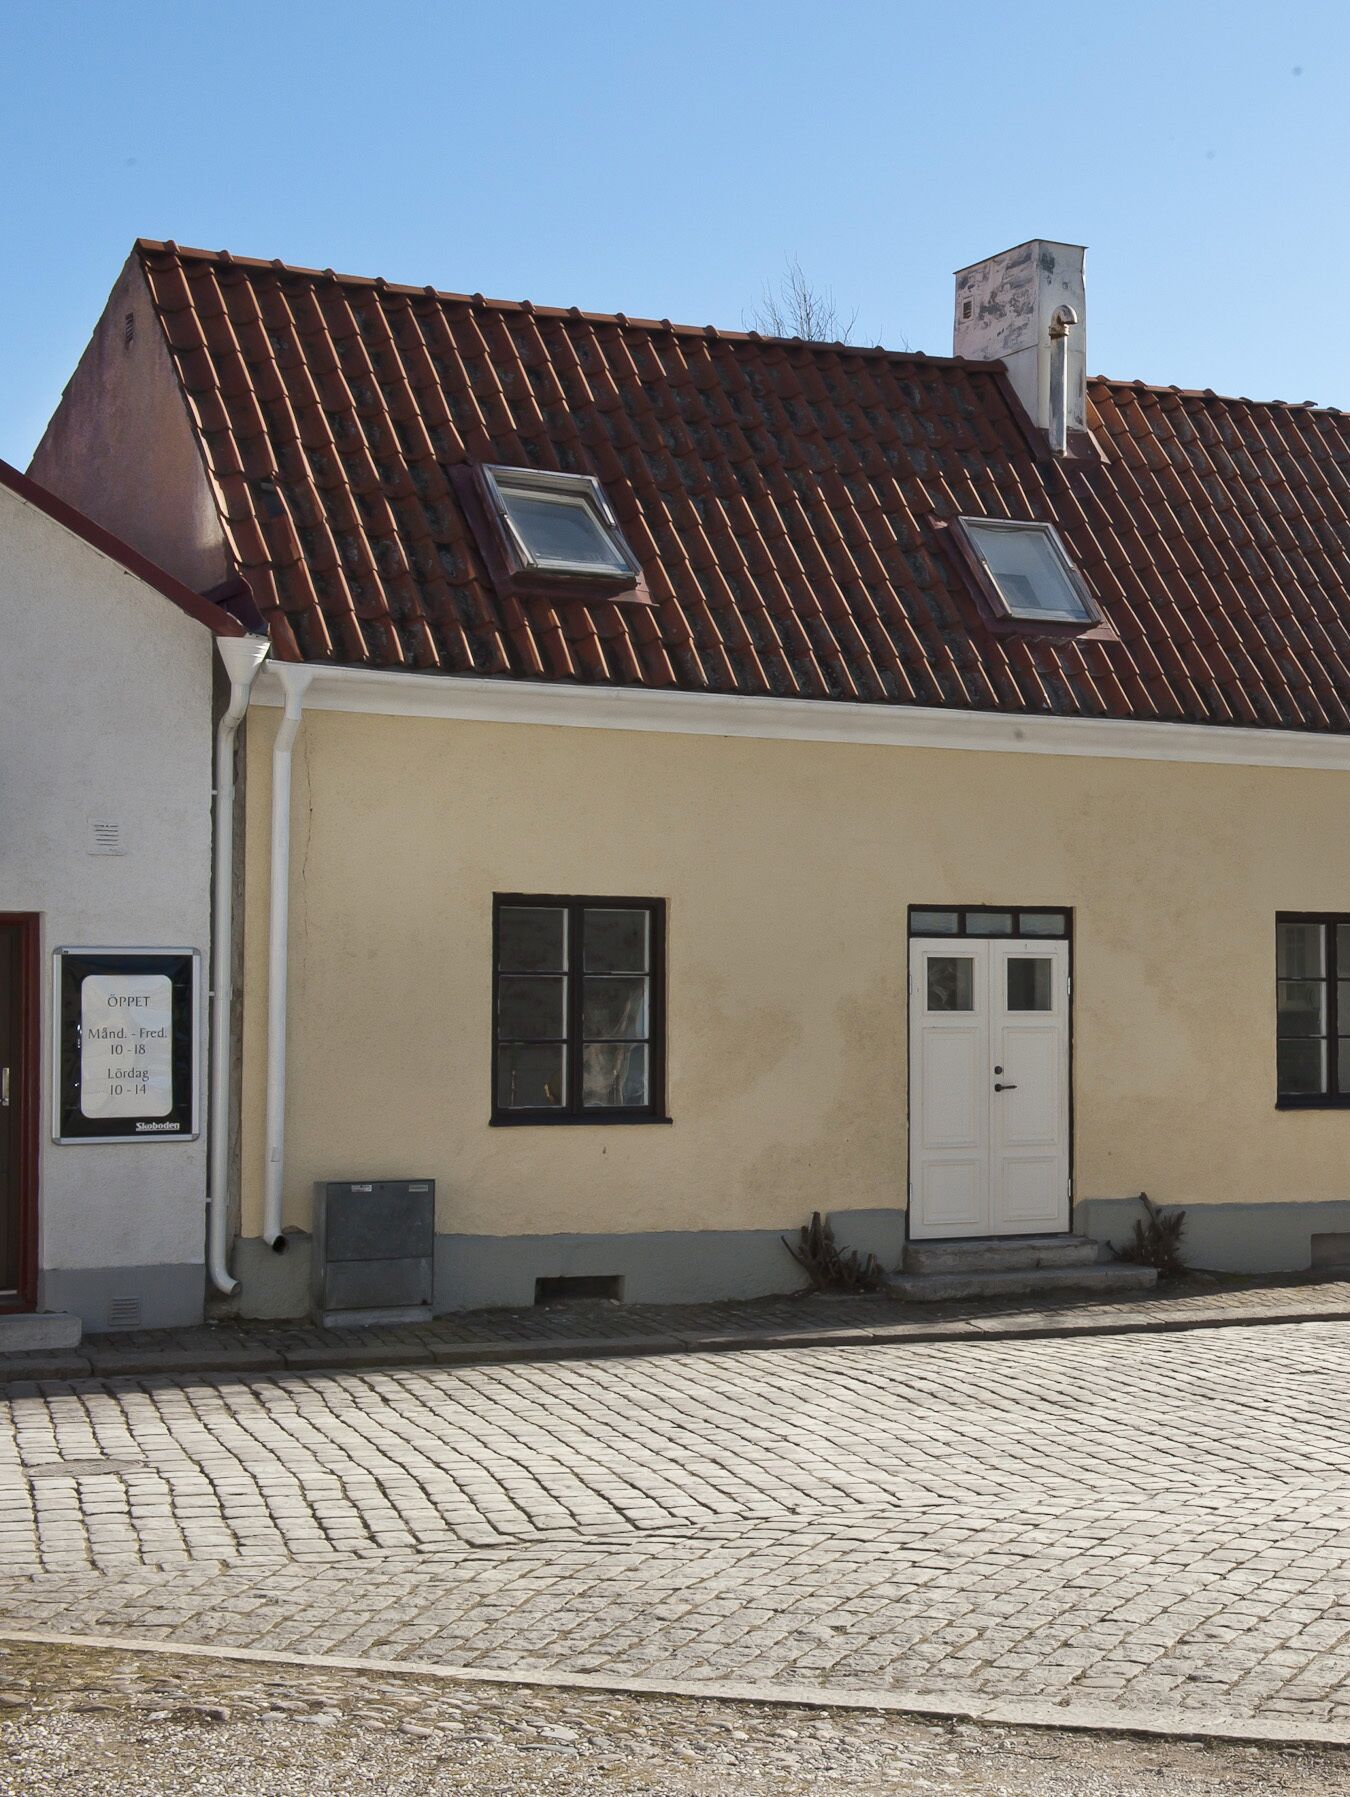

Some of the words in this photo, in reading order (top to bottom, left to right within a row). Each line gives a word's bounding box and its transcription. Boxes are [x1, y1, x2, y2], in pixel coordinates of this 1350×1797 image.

[107, 993, 150, 1007] ÖPPET
[88, 1028, 127, 1039] Månd.
[139, 1027, 168, 1039] Fred.
[110, 1045, 123, 1055] 10
[134, 1044, 146, 1055] 18
[107, 1068, 150, 1081] Lördag
[109, 1084, 123, 1095] 10
[135, 1084, 147, 1095] 14
[135, 1121, 180, 1131] Skoboden
